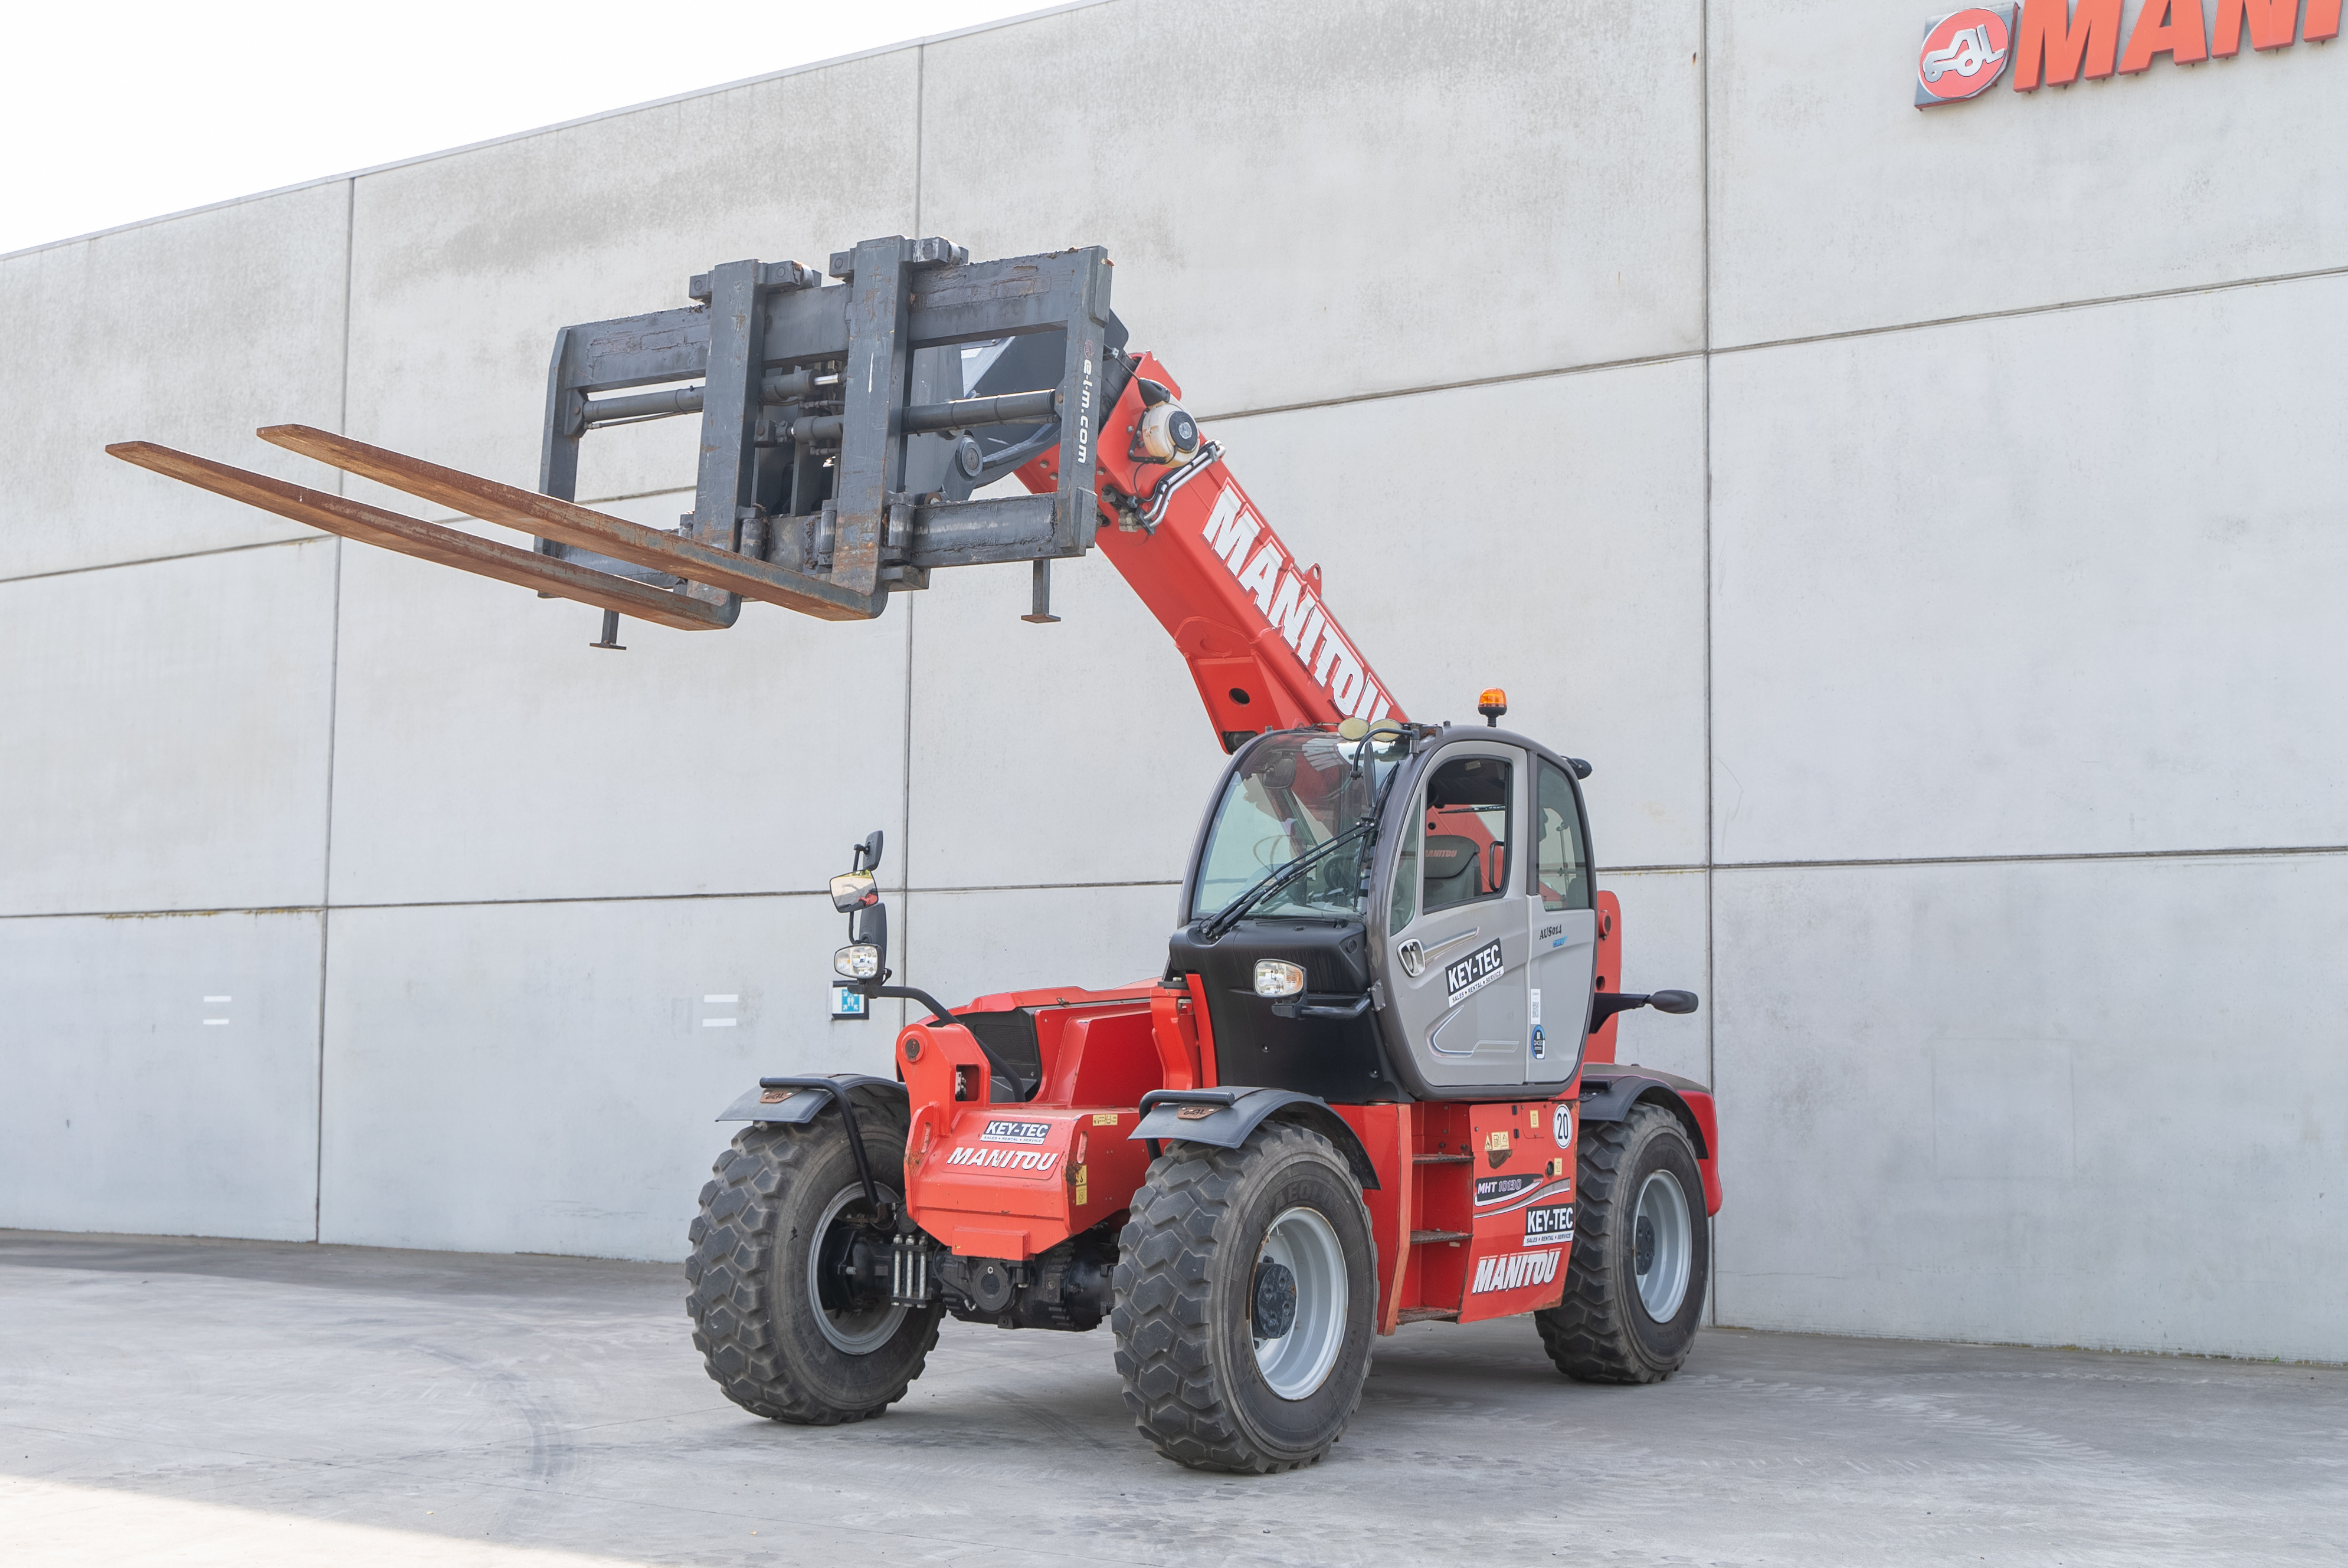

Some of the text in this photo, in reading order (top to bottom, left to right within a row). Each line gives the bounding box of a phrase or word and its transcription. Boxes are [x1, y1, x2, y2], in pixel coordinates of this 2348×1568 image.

[1539, 924, 1562, 940] AUS014
[1448, 944, 1500, 992] KEY-TEC
[1452, 970, 1501, 1003] SALES RENTAL SERVICE
[985, 1121, 1049, 1137] KEY-TEC
[1557, 1113, 1568, 1140] 20
[947, 1147, 1058, 1171] MANITOU
[1478, 1182, 1497, 1195] MHT
[1527, 1207, 1573, 1233] KEY-TEC
[1472, 1251, 1561, 1294] MANITOU
